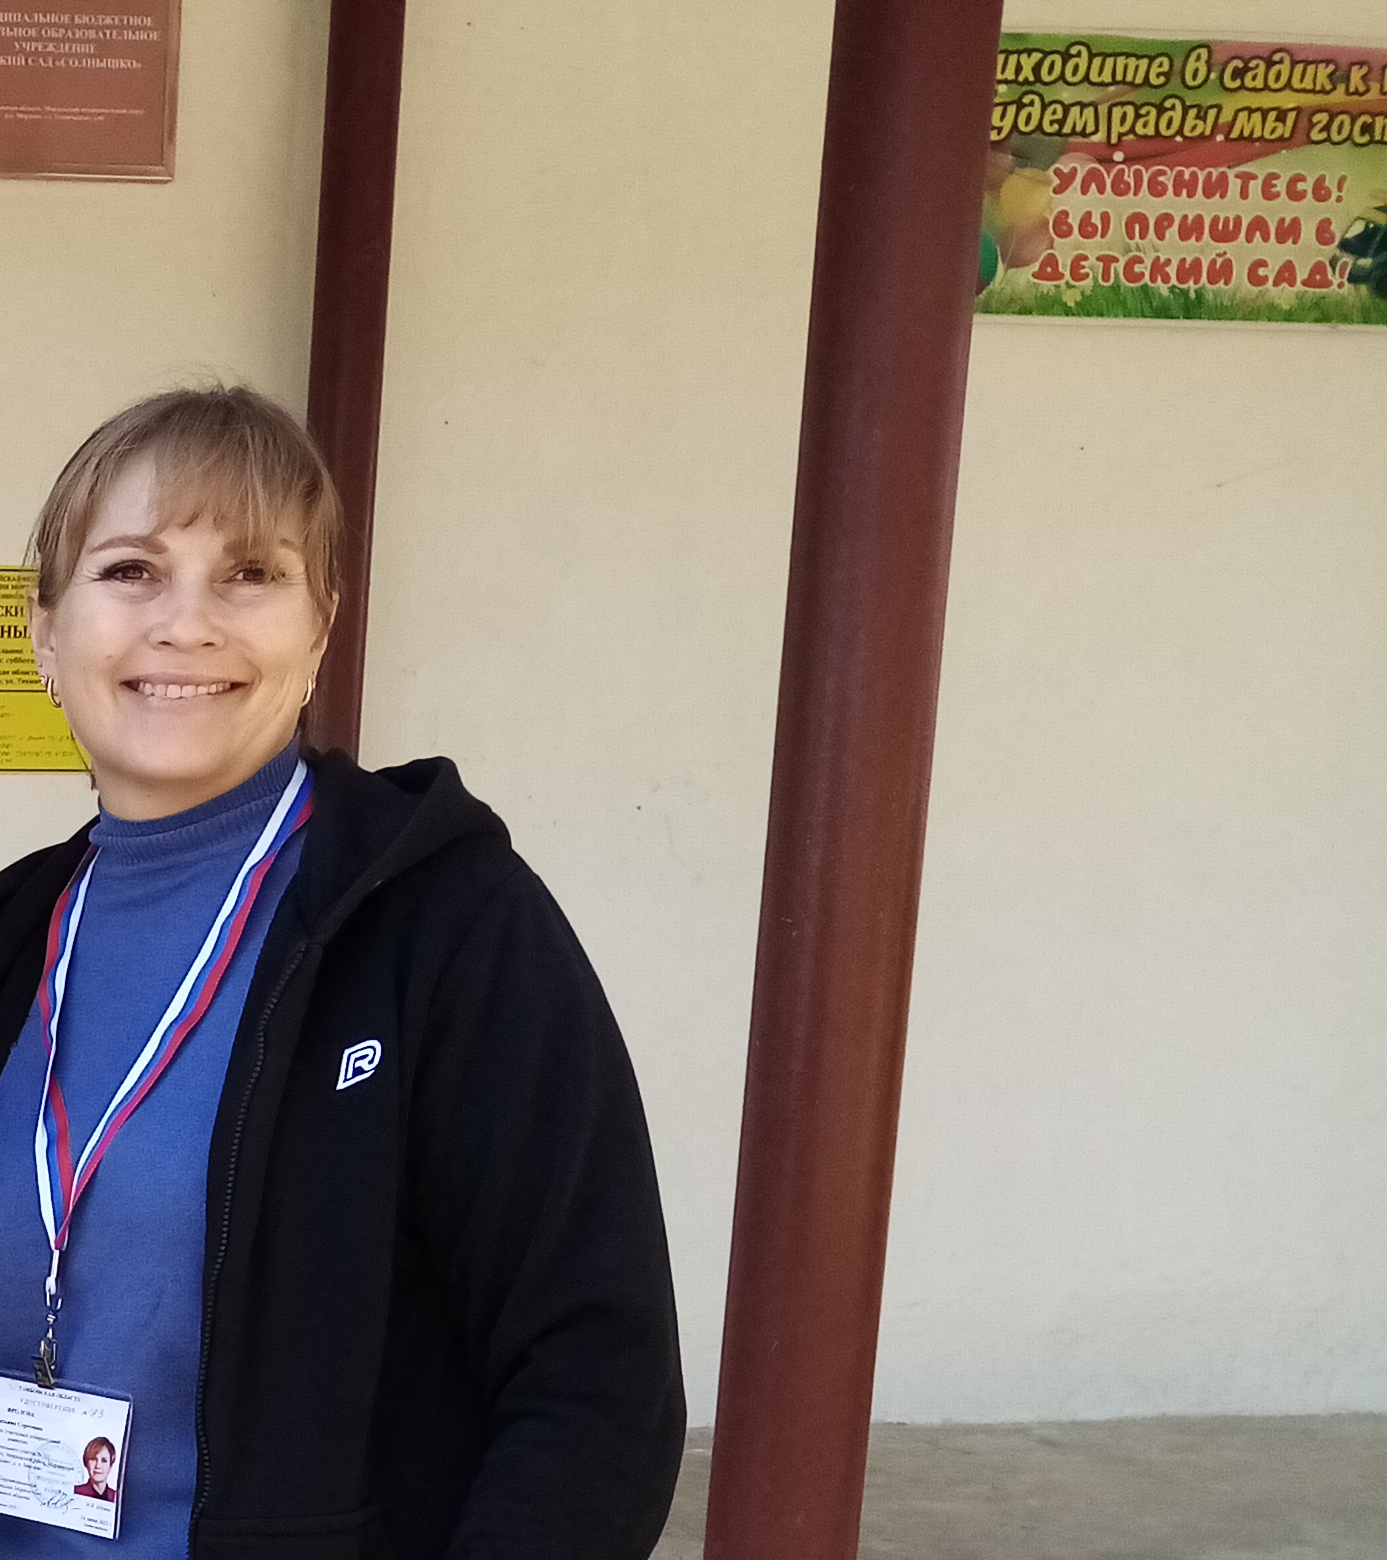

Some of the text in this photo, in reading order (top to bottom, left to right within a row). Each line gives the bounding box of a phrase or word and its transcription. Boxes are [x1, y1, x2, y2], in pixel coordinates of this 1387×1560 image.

[42, 28, 161, 42] ОБРАЗОВАТЕЛЬНОЕ
[74, 14, 154, 27] БЮДЖЕТНОЕ
[995, 41, 1169, 88] иходите
[1183, 43, 1212, 89] в
[1222, 49, 1336, 93] садик
[1346, 63, 1370, 95] к
[990, 91, 1096, 141] удем
[1108, 97, 1218, 144] рады
[1228, 108, 1297, 142] мы
[1050, 163, 1348, 204] УЛЫБНИТЕСЬ!
[1050, 208, 1112, 241] ВЫ
[1124, 210, 1302, 247] ПРИШЛИ
[1031, 250, 1352, 291] ДЕТСКИЙ САД!
